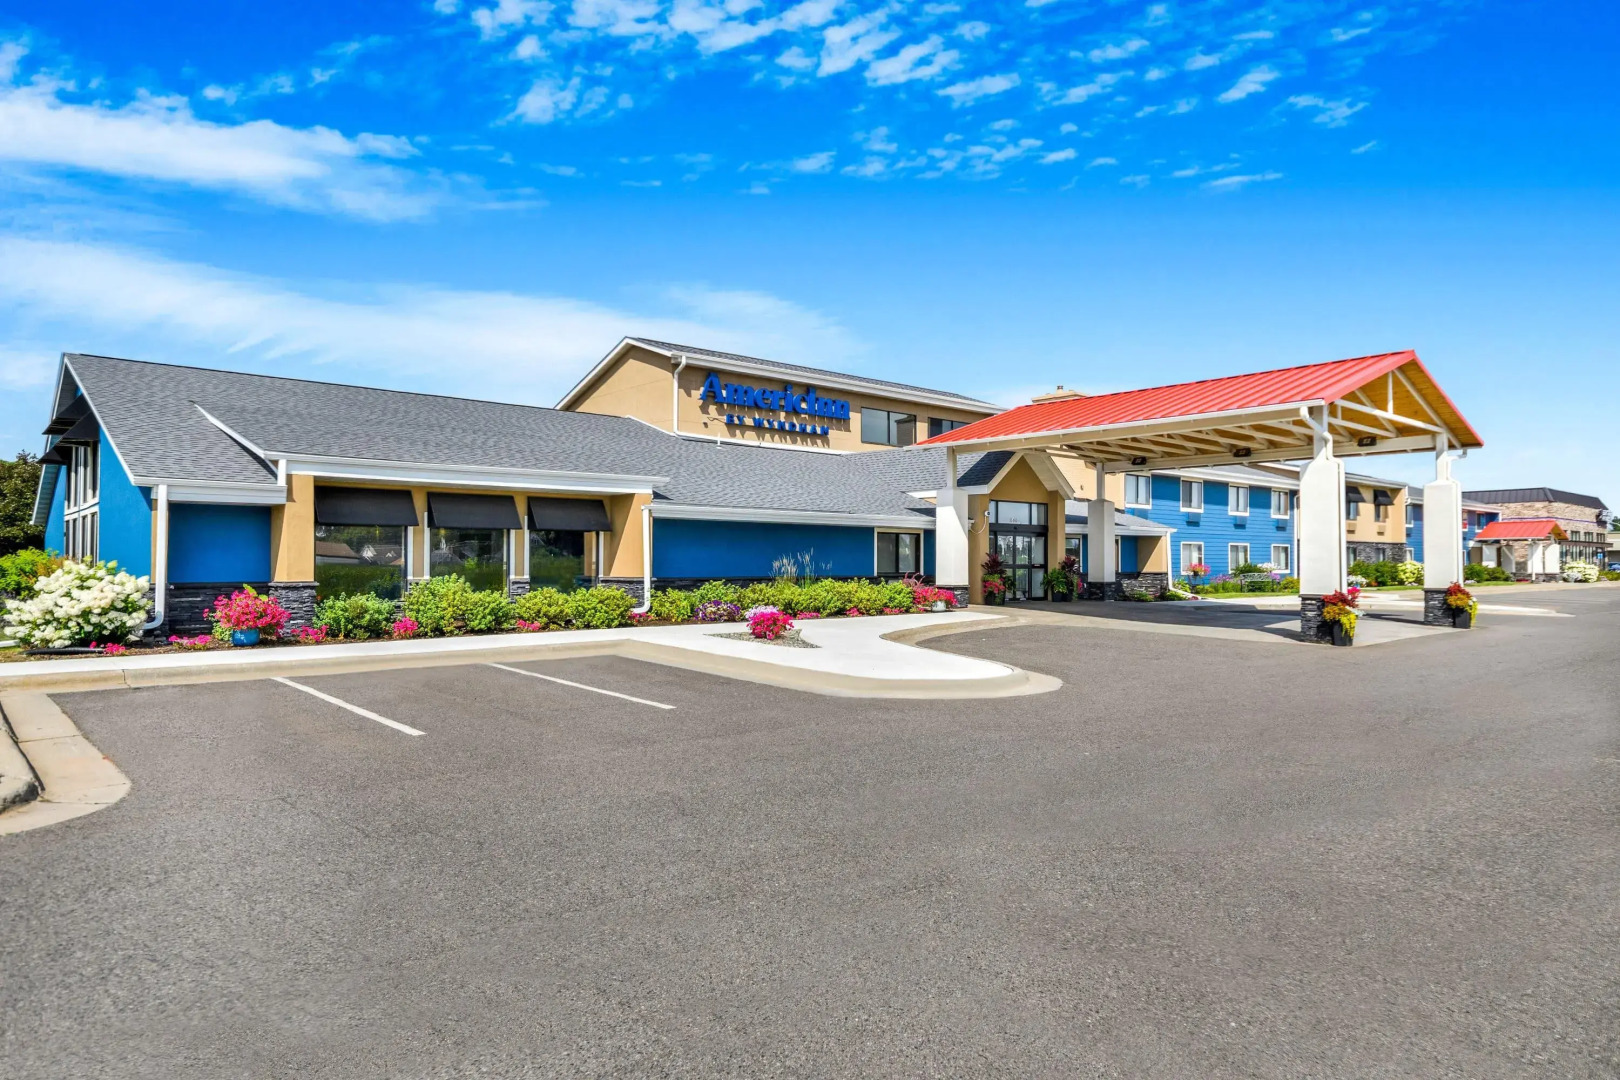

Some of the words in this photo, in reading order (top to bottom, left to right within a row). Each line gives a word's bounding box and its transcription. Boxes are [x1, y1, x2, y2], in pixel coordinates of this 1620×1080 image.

[700, 372, 850, 420] AmericInn
[726, 414, 745, 426] BY
[753, 417, 830, 436] WYNDHAM
